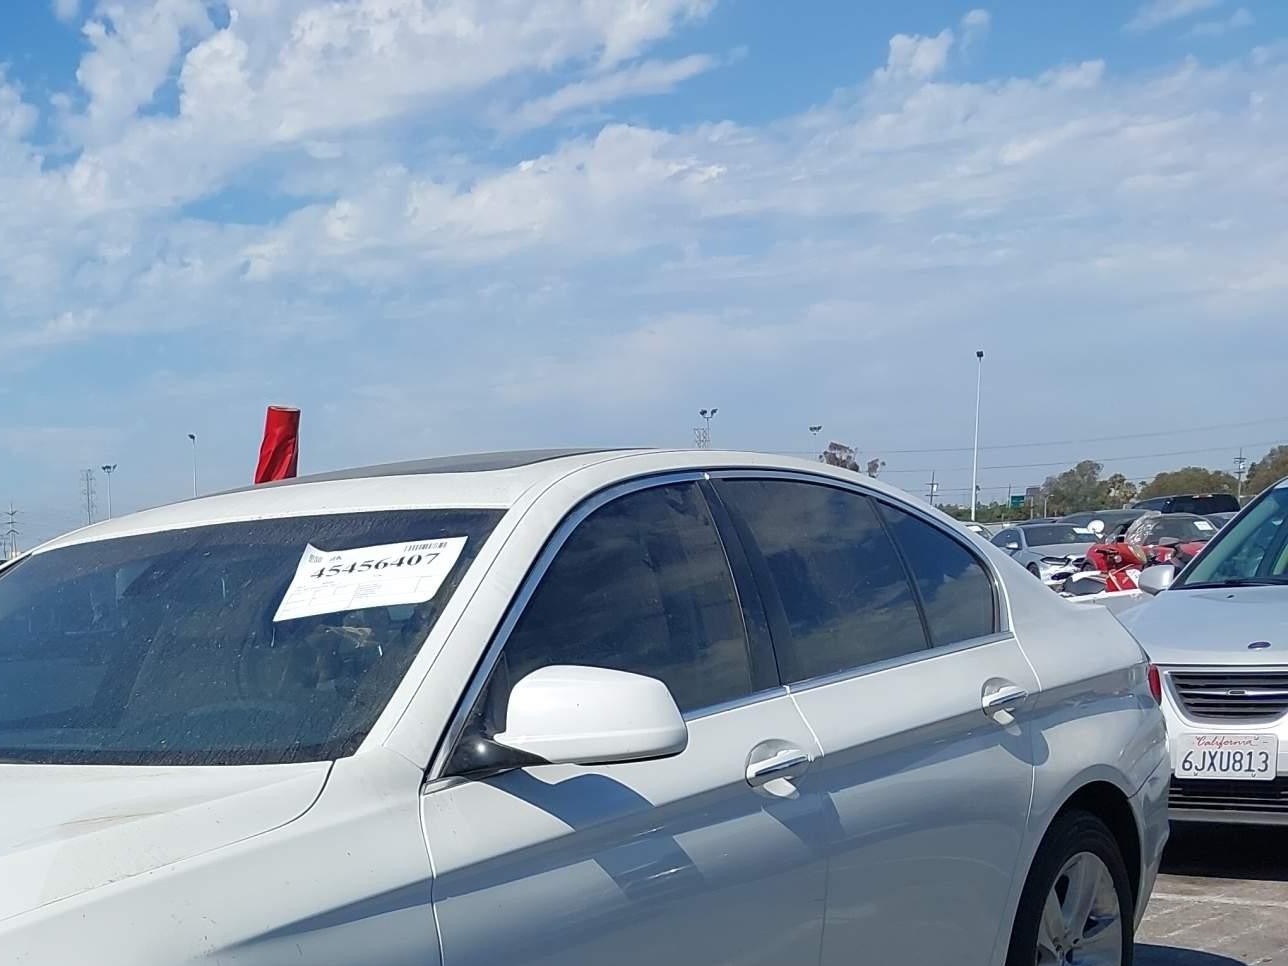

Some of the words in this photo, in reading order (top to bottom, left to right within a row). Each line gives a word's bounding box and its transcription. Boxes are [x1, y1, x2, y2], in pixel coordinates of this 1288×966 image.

[310, 552, 440, 579] 45456407
[1196, 736, 1255, 749] California
[1182, 751, 1269, 772] 6JXU813
